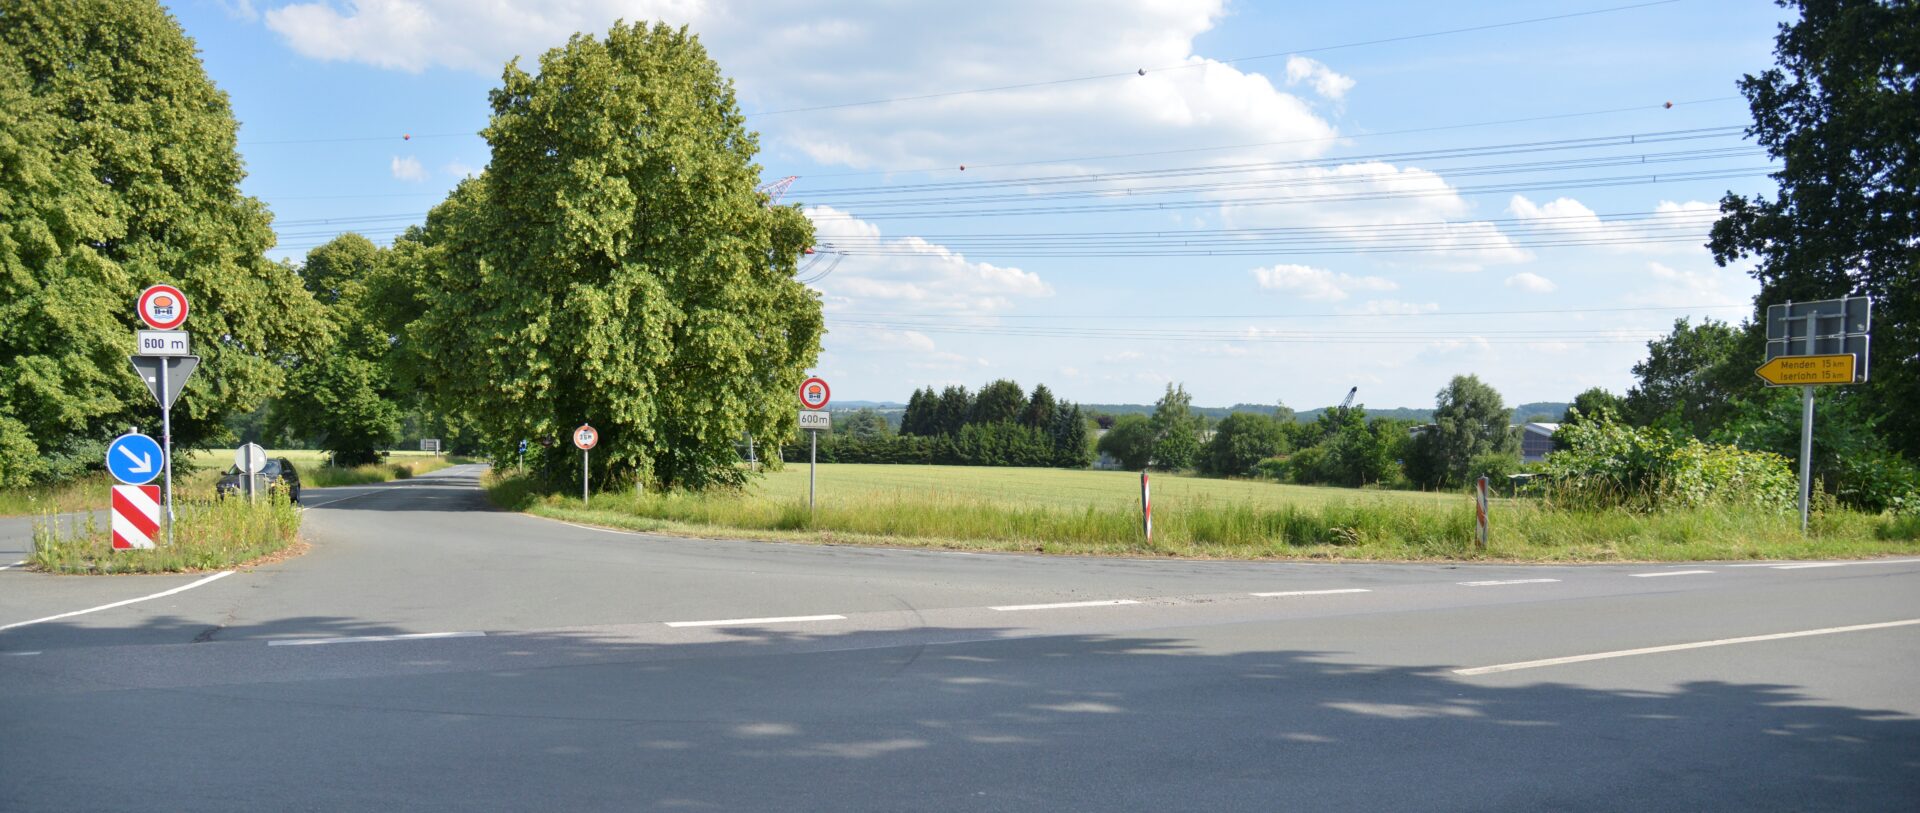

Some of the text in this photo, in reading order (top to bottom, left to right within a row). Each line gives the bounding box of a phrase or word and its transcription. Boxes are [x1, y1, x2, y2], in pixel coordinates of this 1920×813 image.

[144, 338, 184, 349] 600 m
[1781, 361, 1816, 369] Menden
[1822, 360, 1832, 368] 15
[1780, 372, 1818, 381] Iserlohn
[1822, 371, 1831, 379] 15
